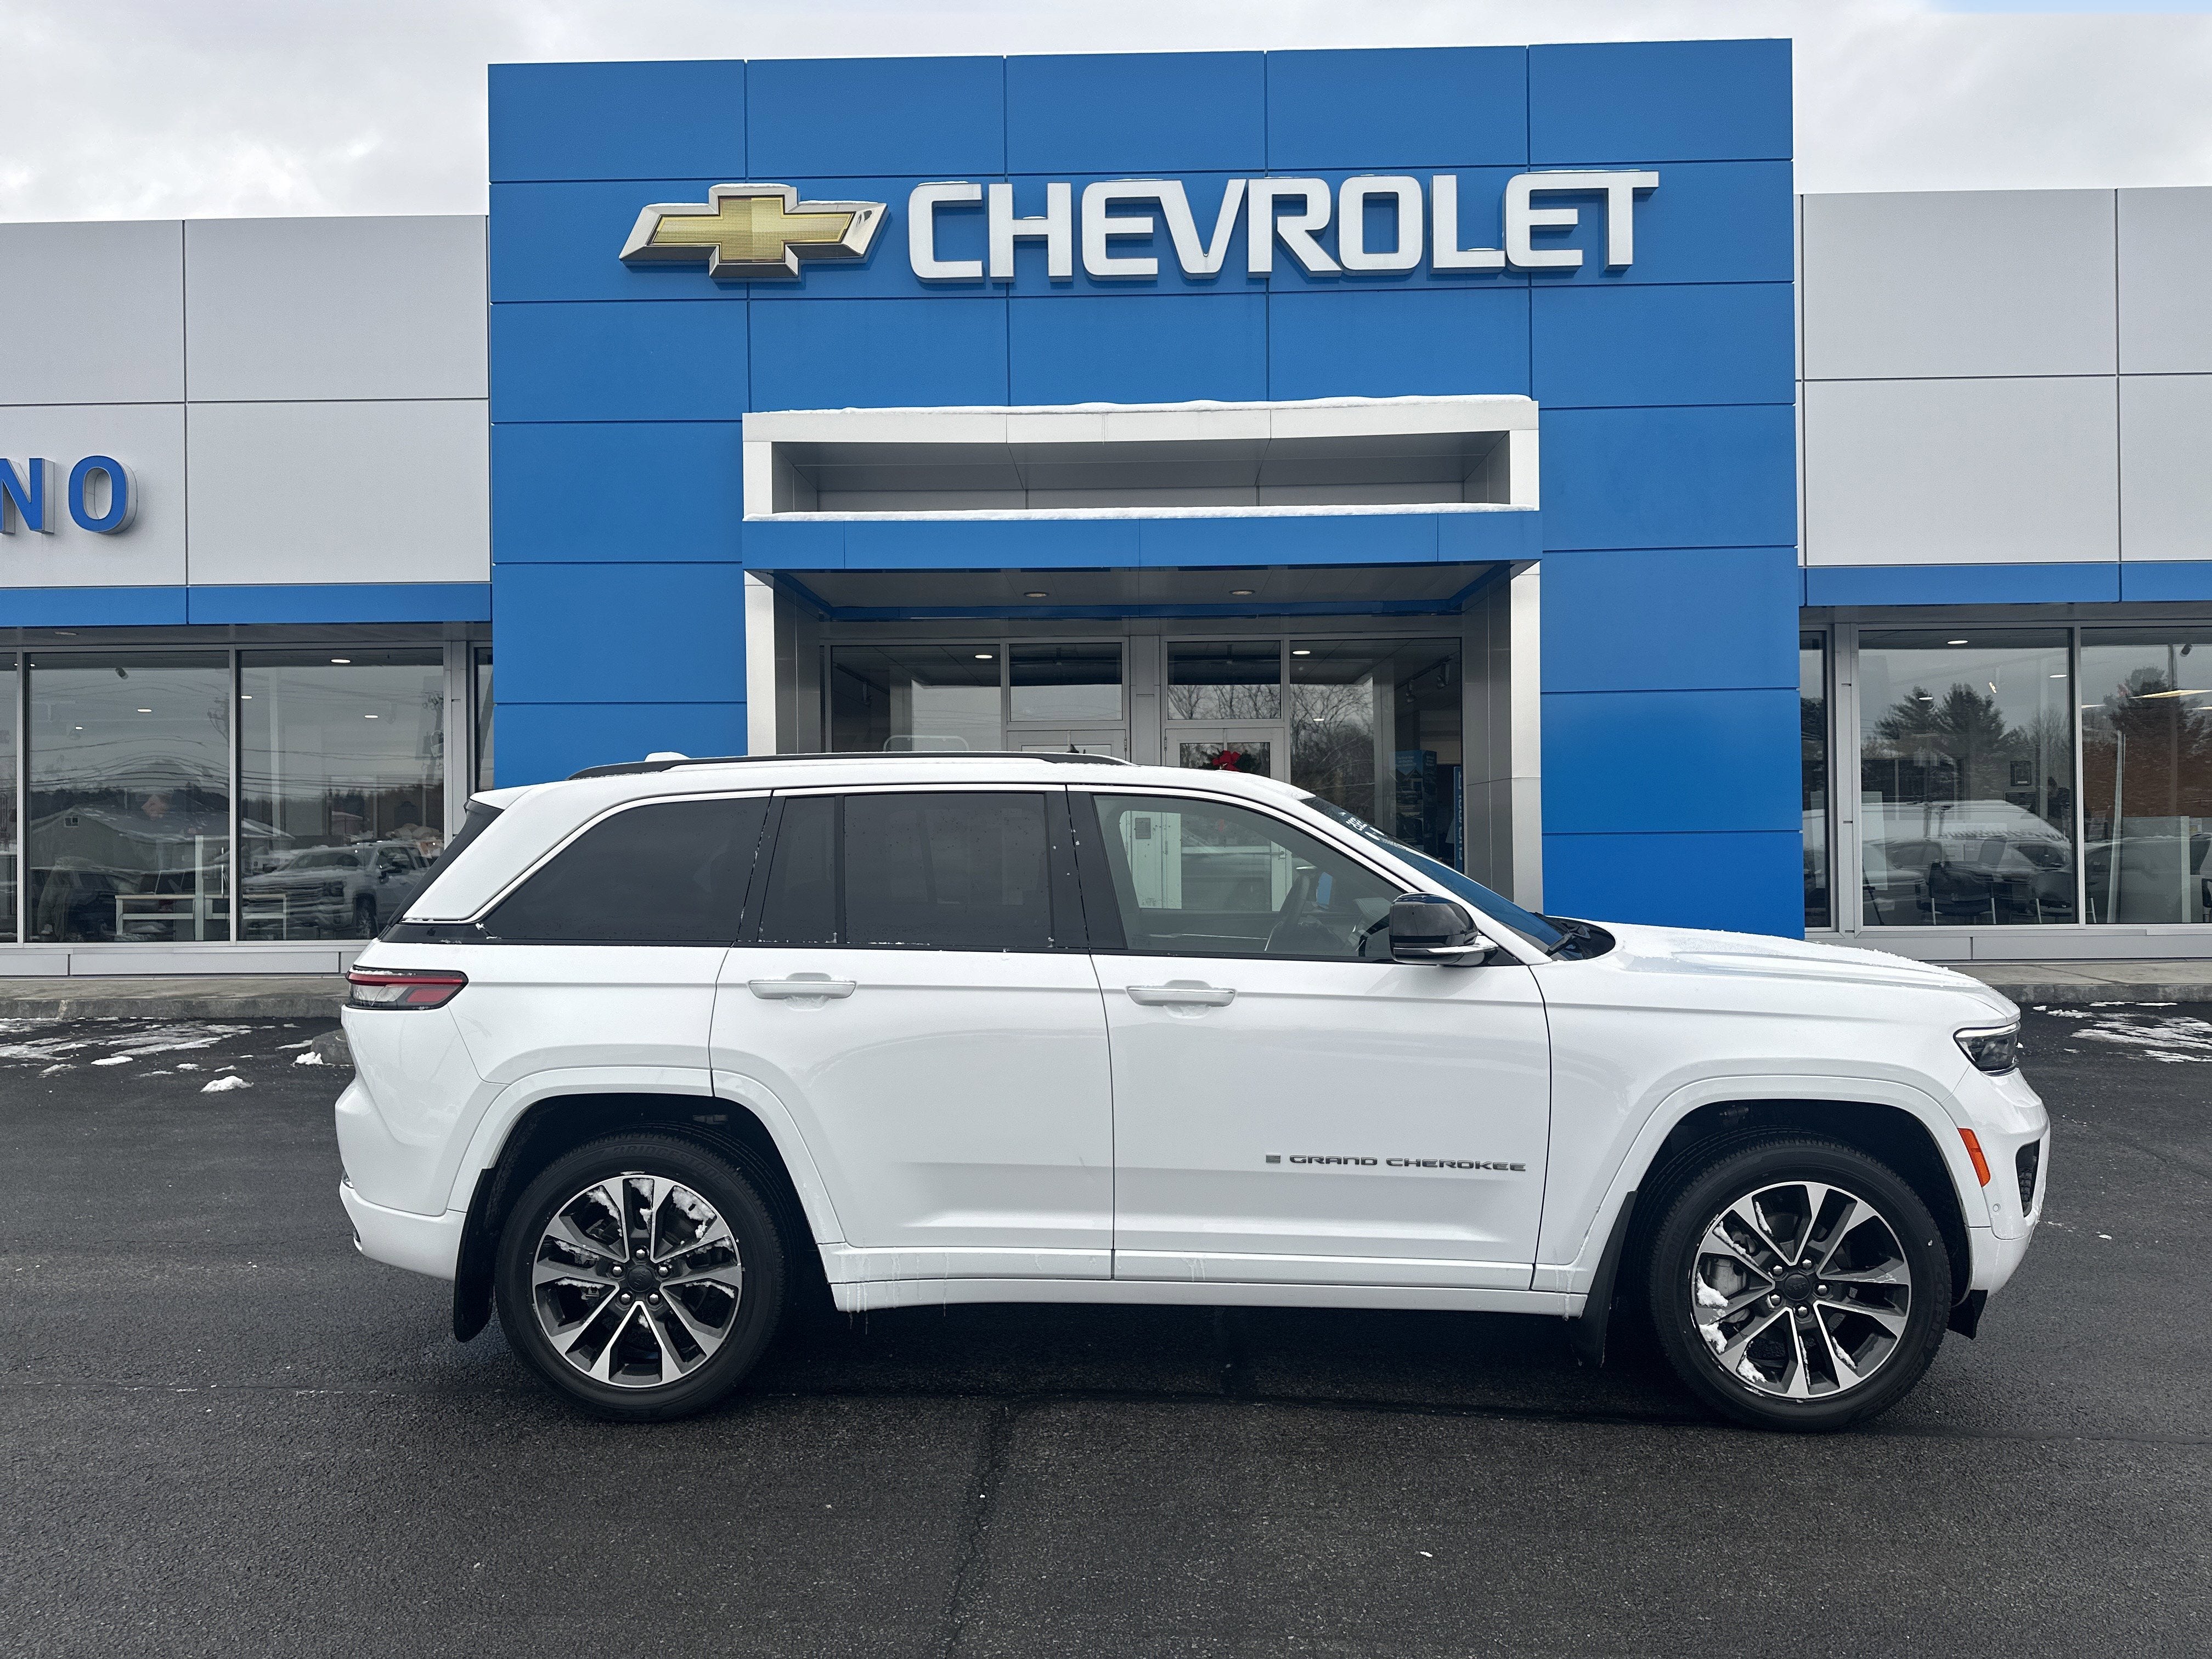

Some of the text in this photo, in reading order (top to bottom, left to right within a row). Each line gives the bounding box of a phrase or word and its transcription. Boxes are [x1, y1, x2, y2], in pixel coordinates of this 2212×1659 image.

[908, 171, 1659, 280] CHEVROLET
[0, 455, 137, 535] NO
[1289, 1154, 1527, 1172] GRAND CHEROKEE
